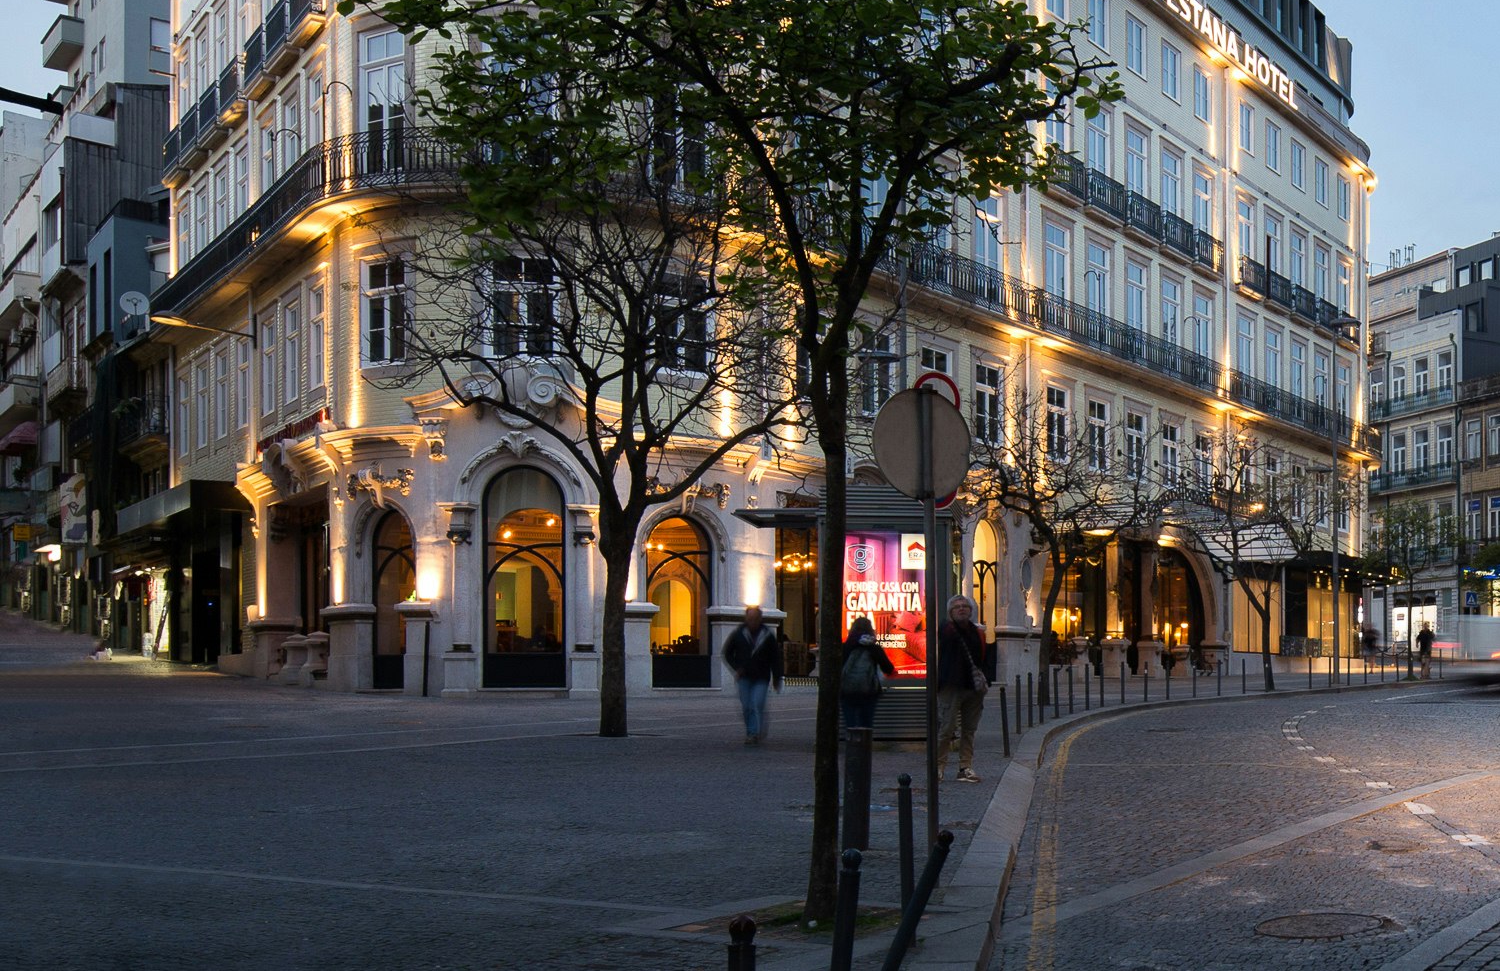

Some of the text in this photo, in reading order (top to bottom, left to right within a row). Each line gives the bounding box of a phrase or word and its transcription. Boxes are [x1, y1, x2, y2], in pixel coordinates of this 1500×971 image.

[1244, 43, 1299, 110] HOTEL
[846, 581, 919, 593] VENDER CASA COM
[846, 592, 922, 611] GARANTIA
